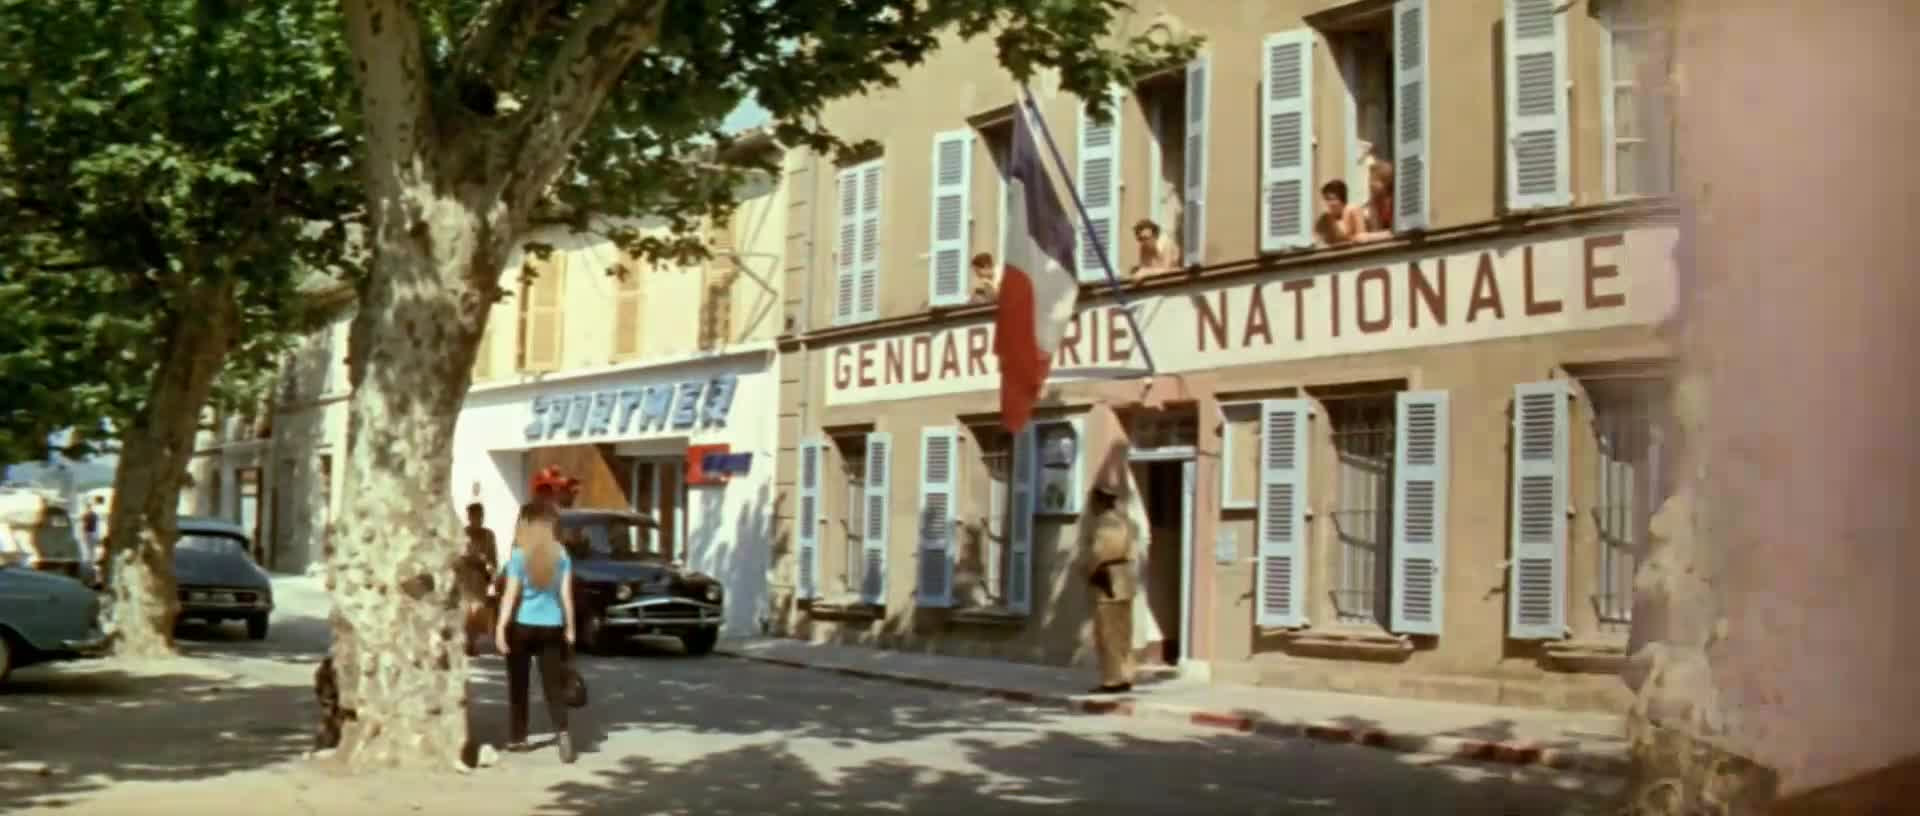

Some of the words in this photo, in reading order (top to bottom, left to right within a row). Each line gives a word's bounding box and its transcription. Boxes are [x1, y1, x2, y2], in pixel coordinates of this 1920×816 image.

[833, 307, 1132, 390] GENDARRIE
[1196, 234, 1626, 353] NATIONALE
[524, 373, 738, 441] SPORTMER
